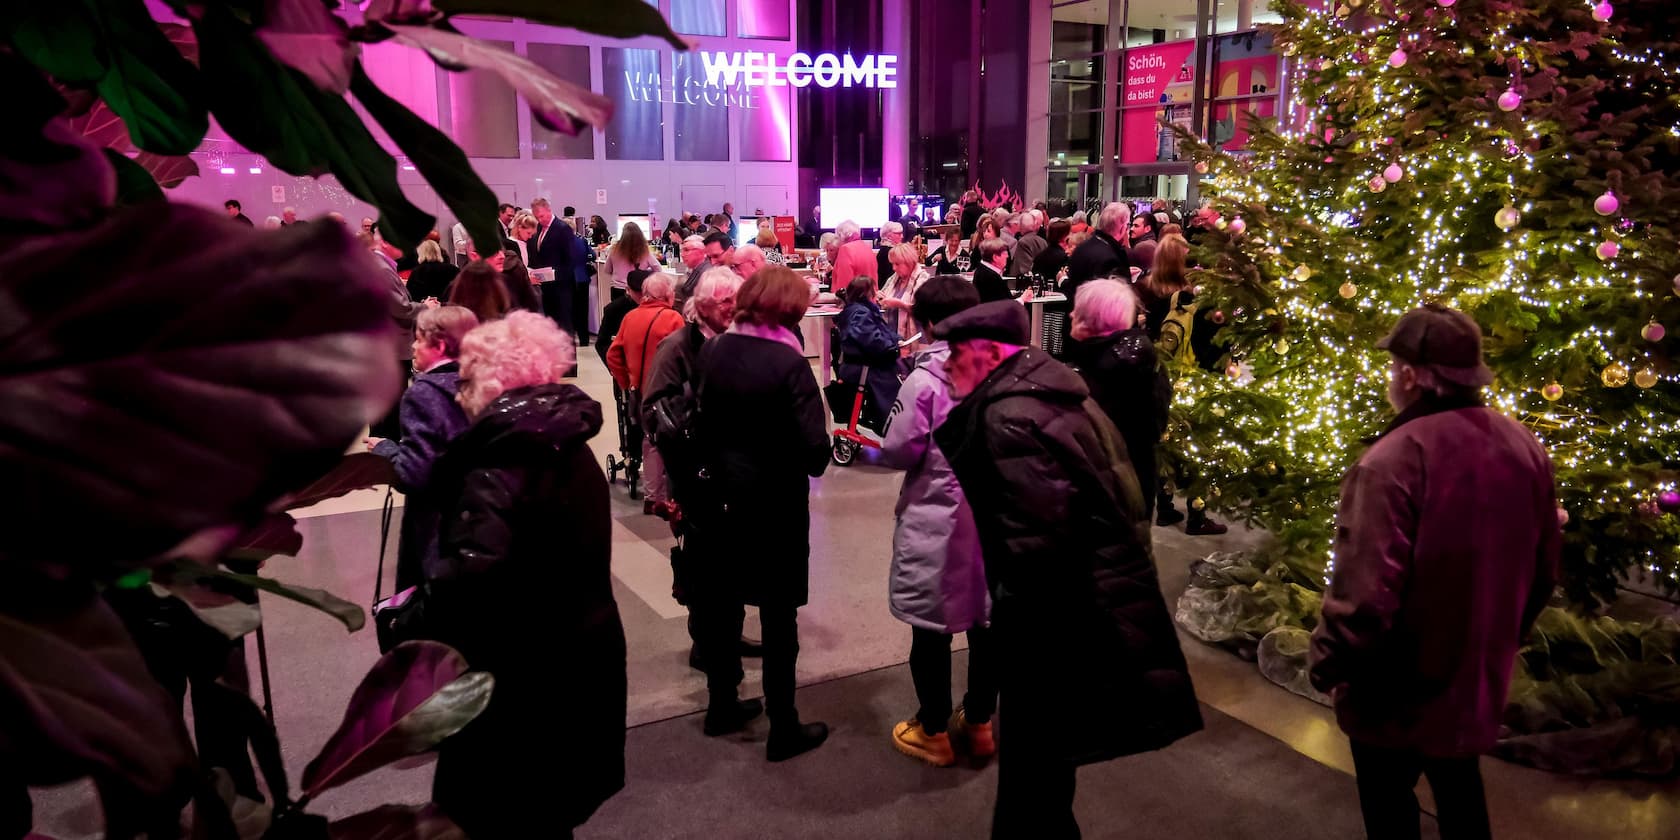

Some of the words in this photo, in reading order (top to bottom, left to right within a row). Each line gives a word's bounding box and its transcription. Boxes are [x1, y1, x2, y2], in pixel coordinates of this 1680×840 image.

[701, 51, 897, 88] WELCOME
[1128, 53, 1166, 70] Schön,
[1128, 76, 1145, 86] dass
[1146, 74, 1156, 84] du
[624, 70, 760, 109] WELCOME
[1127, 90, 1137, 101] da
[1138, 89, 1155, 100] bist!
